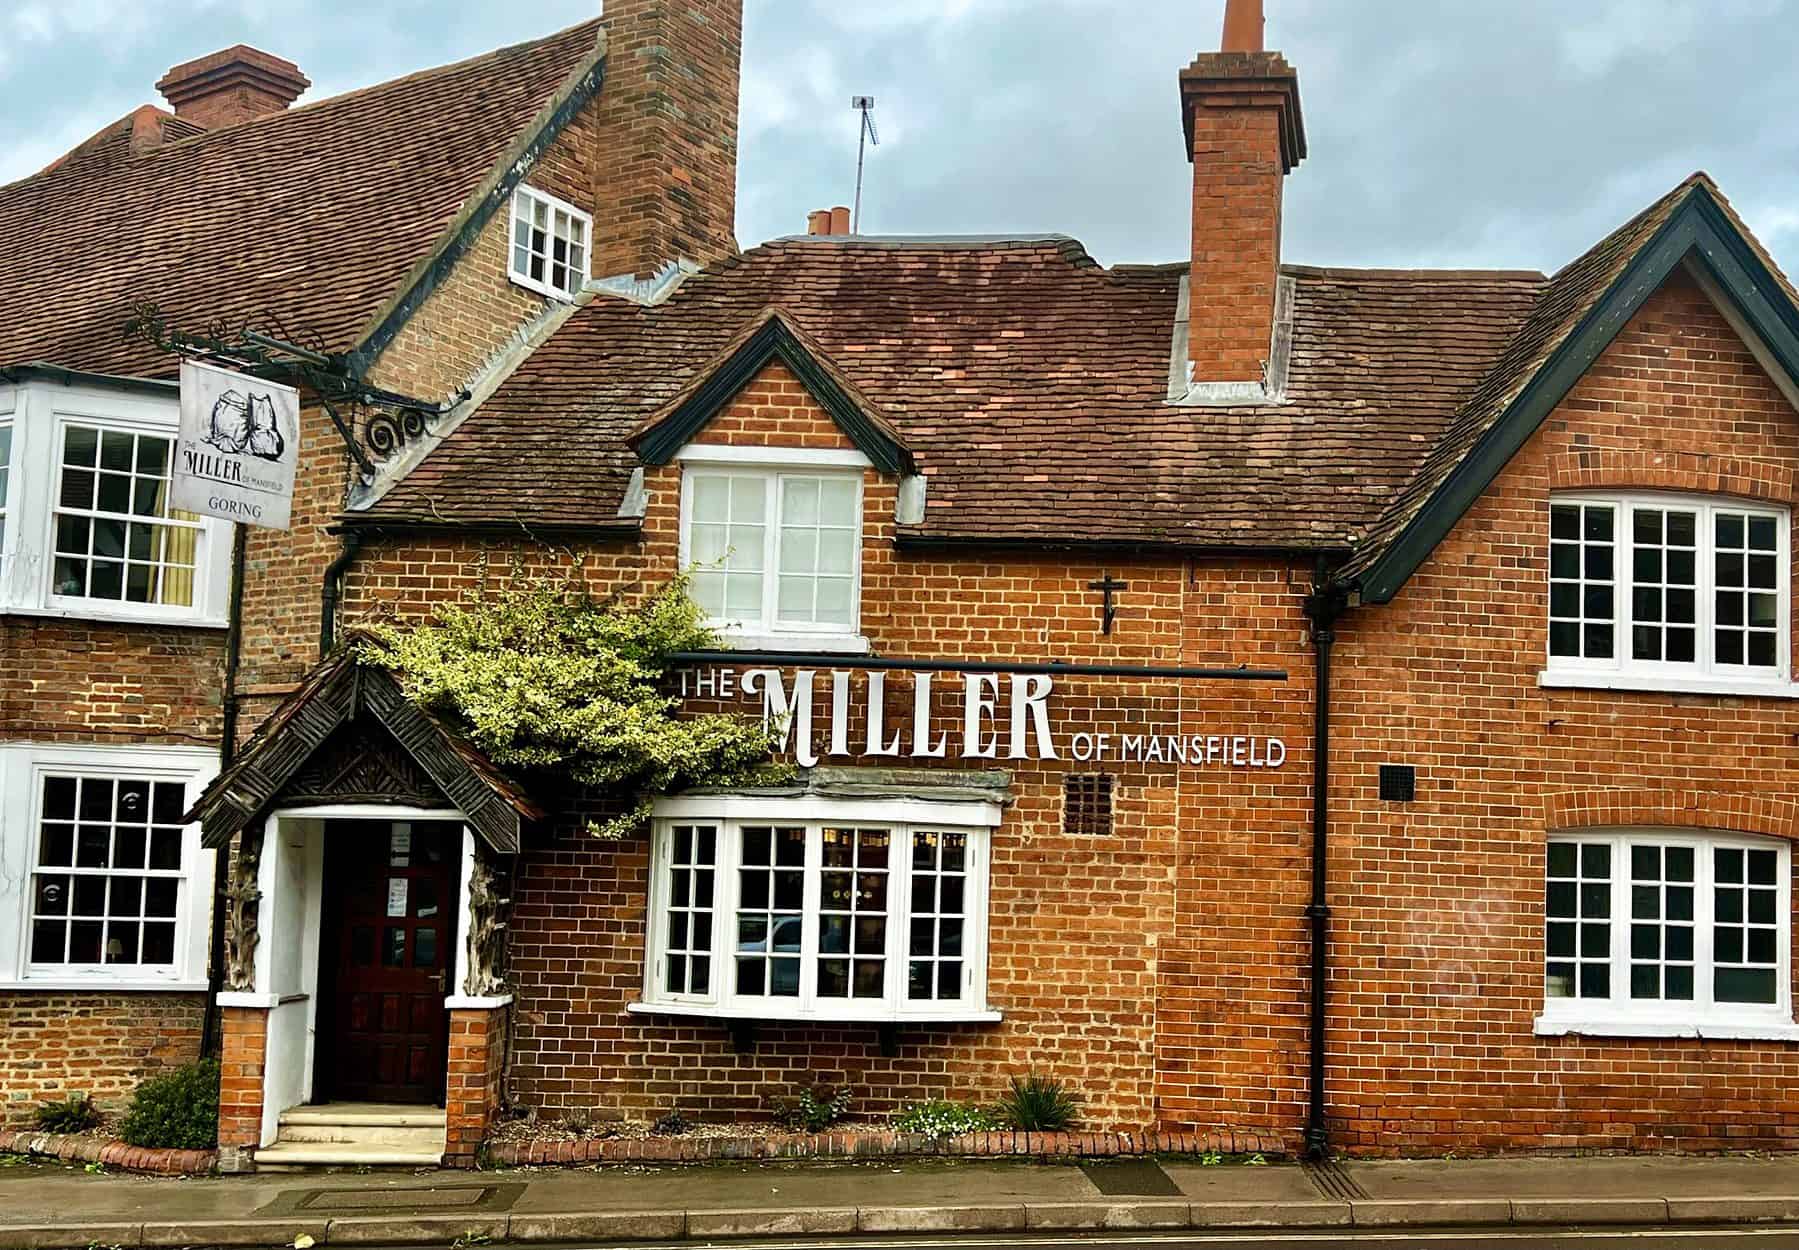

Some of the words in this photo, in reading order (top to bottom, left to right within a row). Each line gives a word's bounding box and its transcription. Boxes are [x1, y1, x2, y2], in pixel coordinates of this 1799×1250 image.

[184, 450, 242, 482] MILLER
[209, 496, 262, 519] GORING
[675, 668, 734, 697] THE
[741, 669, 1059, 768] MILLER
[1071, 732, 1109, 761] OF
[1121, 735, 1286, 767] MANSFIELD
